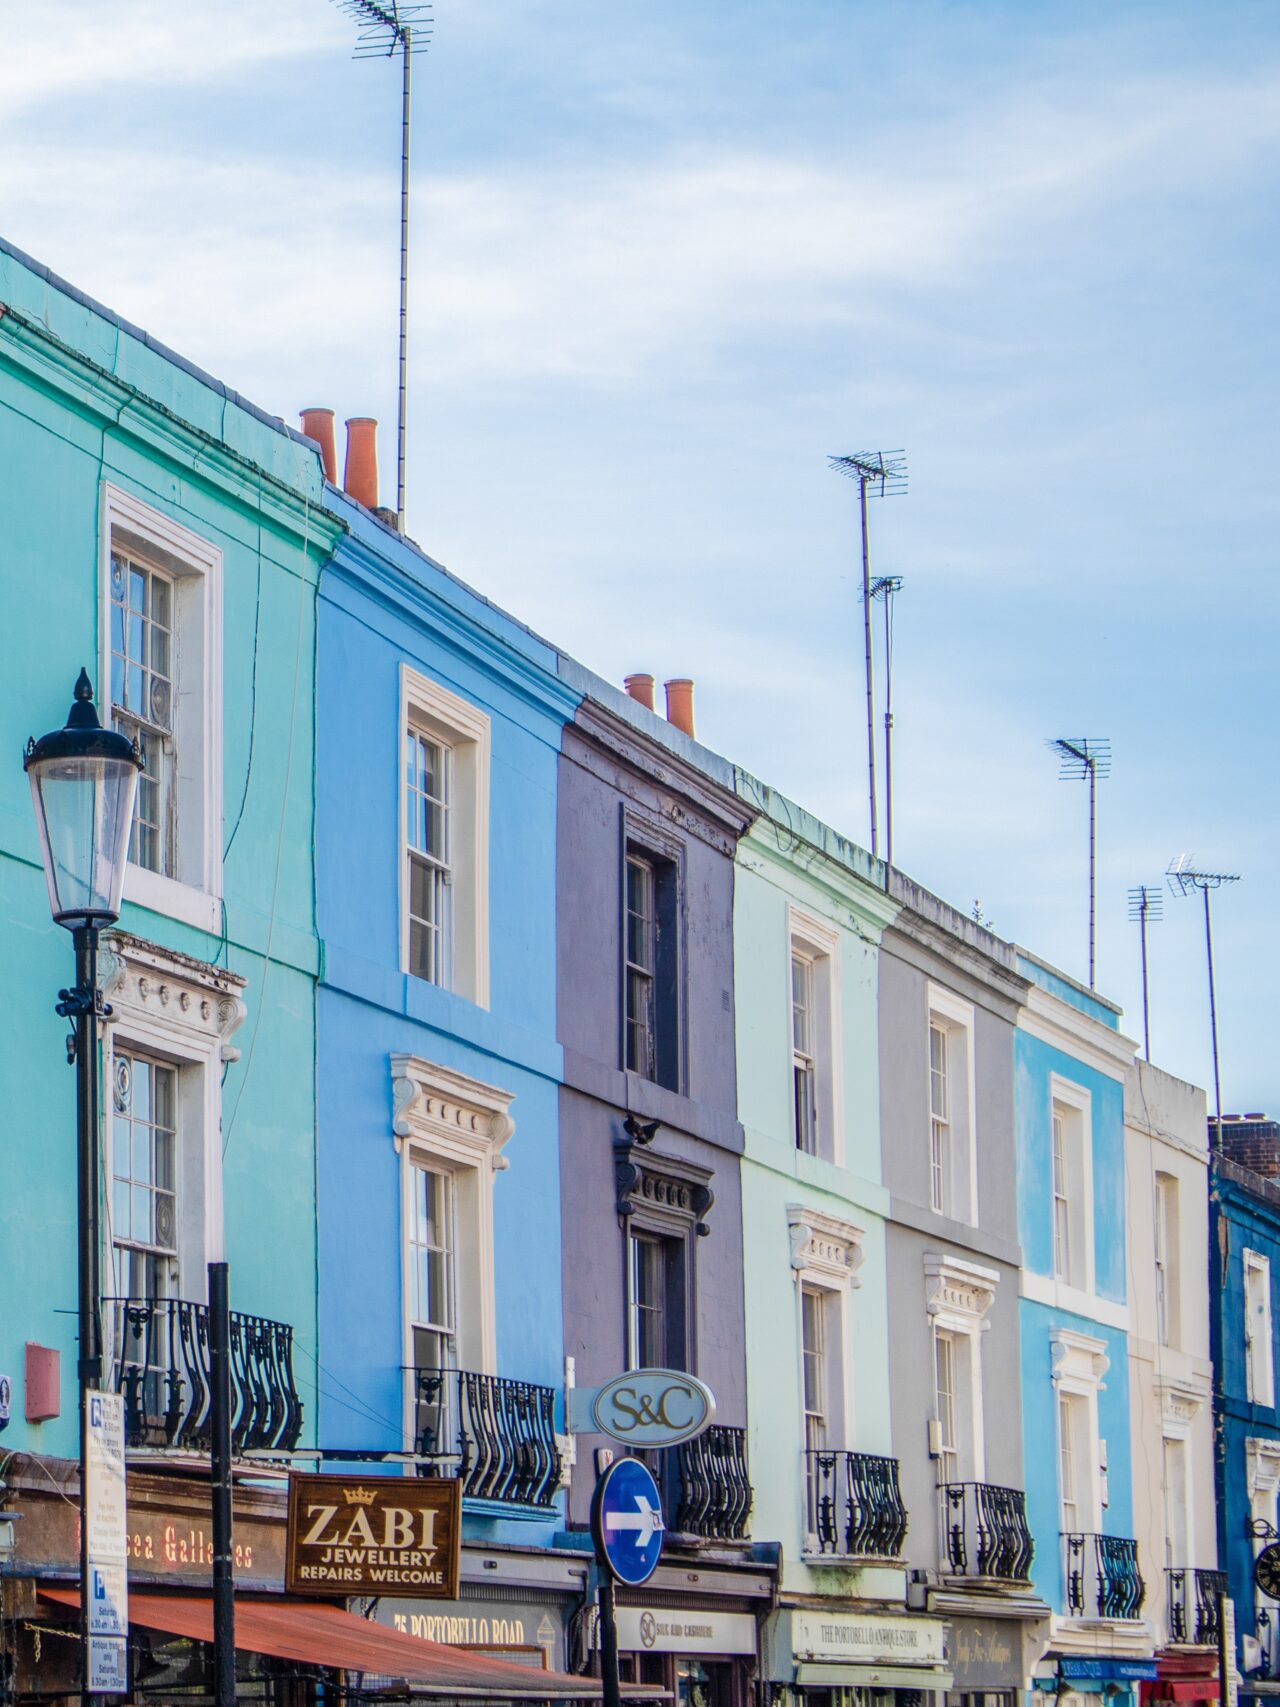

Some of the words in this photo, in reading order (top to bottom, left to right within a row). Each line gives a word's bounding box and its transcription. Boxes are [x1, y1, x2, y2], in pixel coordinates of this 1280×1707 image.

[612, 1386, 694, 1431] S&C
[302, 1505, 439, 1549] ZABI
[164, 1525, 252, 1569] Gallees
[321, 1549, 436, 1566] JEWELLERY
[301, 1566, 362, 1581] REPAIRS
[370, 1568, 443, 1584] WELCOME
[410, 1614, 489, 1644] PORTOBELLO
[491, 1617, 525, 1645] ROAD
[821, 1625, 833, 1643] THE
[834, 1625, 873, 1645] PORTOBELLO
[900, 1630, 918, 1648] STORE
